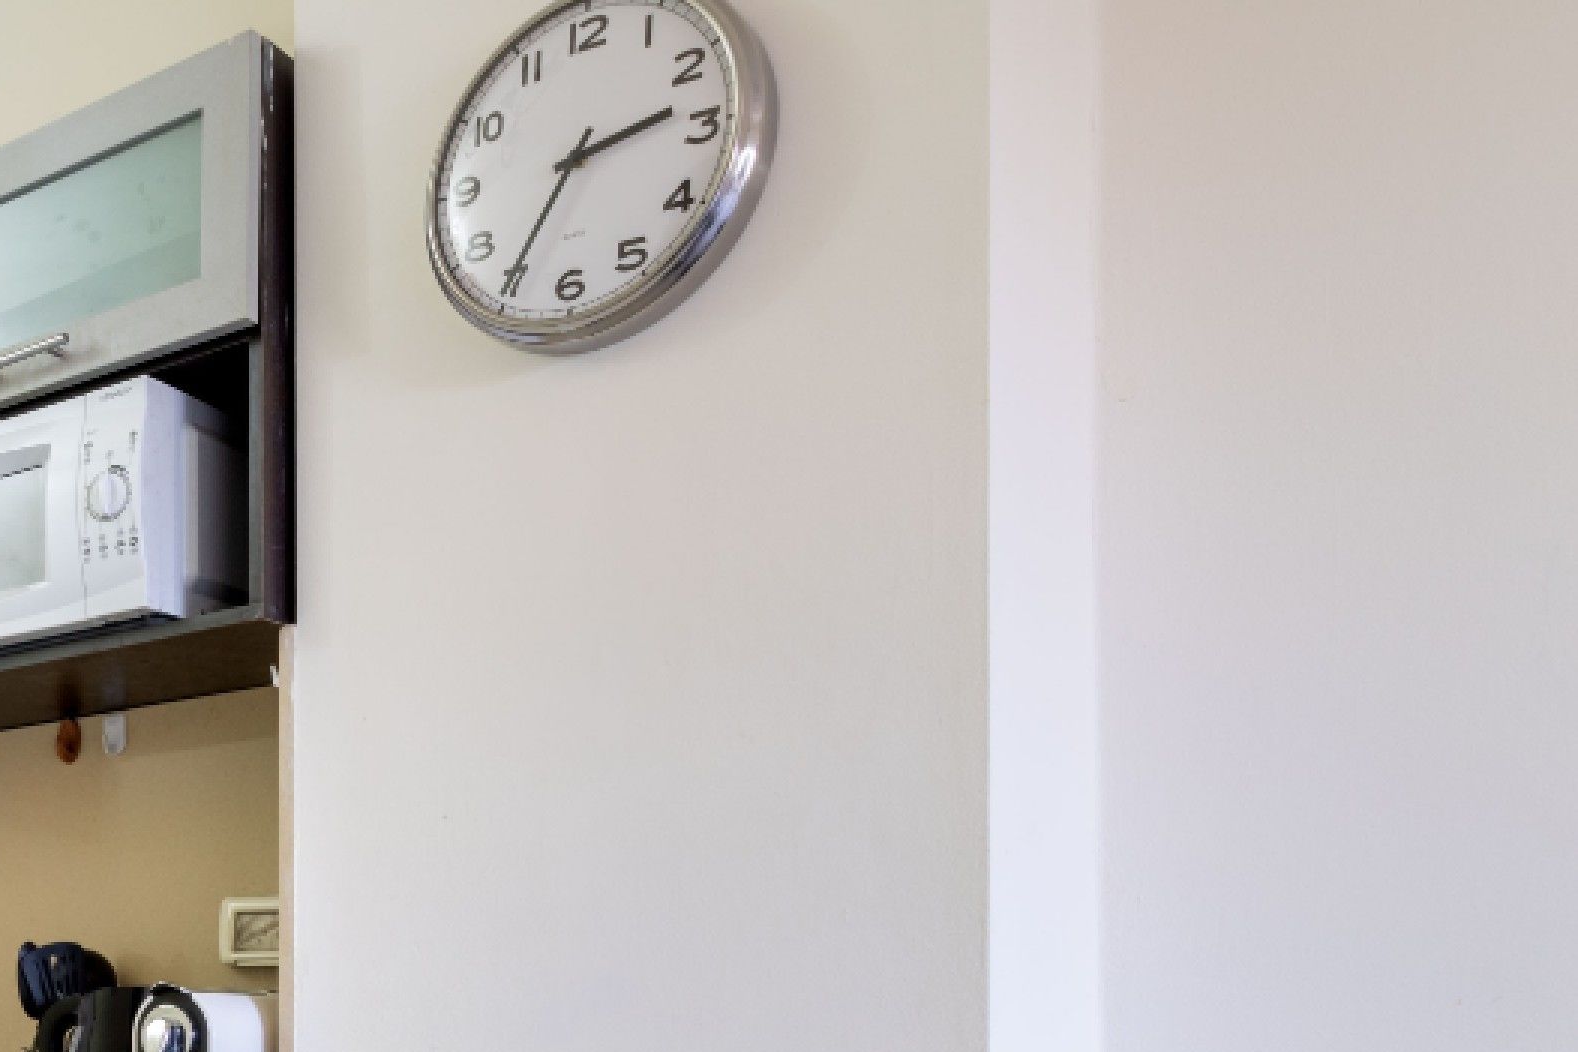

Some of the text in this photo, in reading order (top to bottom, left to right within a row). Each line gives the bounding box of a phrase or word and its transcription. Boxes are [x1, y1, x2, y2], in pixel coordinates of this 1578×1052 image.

[569, 13, 610, 57] 12
[644, 13, 655, 49] 1
[521, 50, 543, 88] 11
[672, 47, 706, 88] 2
[473, 110, 505, 148] 10
[685, 104, 721, 145] 3
[454, 176, 481, 208] 9
[662, 178, 694, 213] 4
[465, 230, 496, 264] 8
[615, 236, 649, 272] 5
[554, 269, 586, 302] 6
